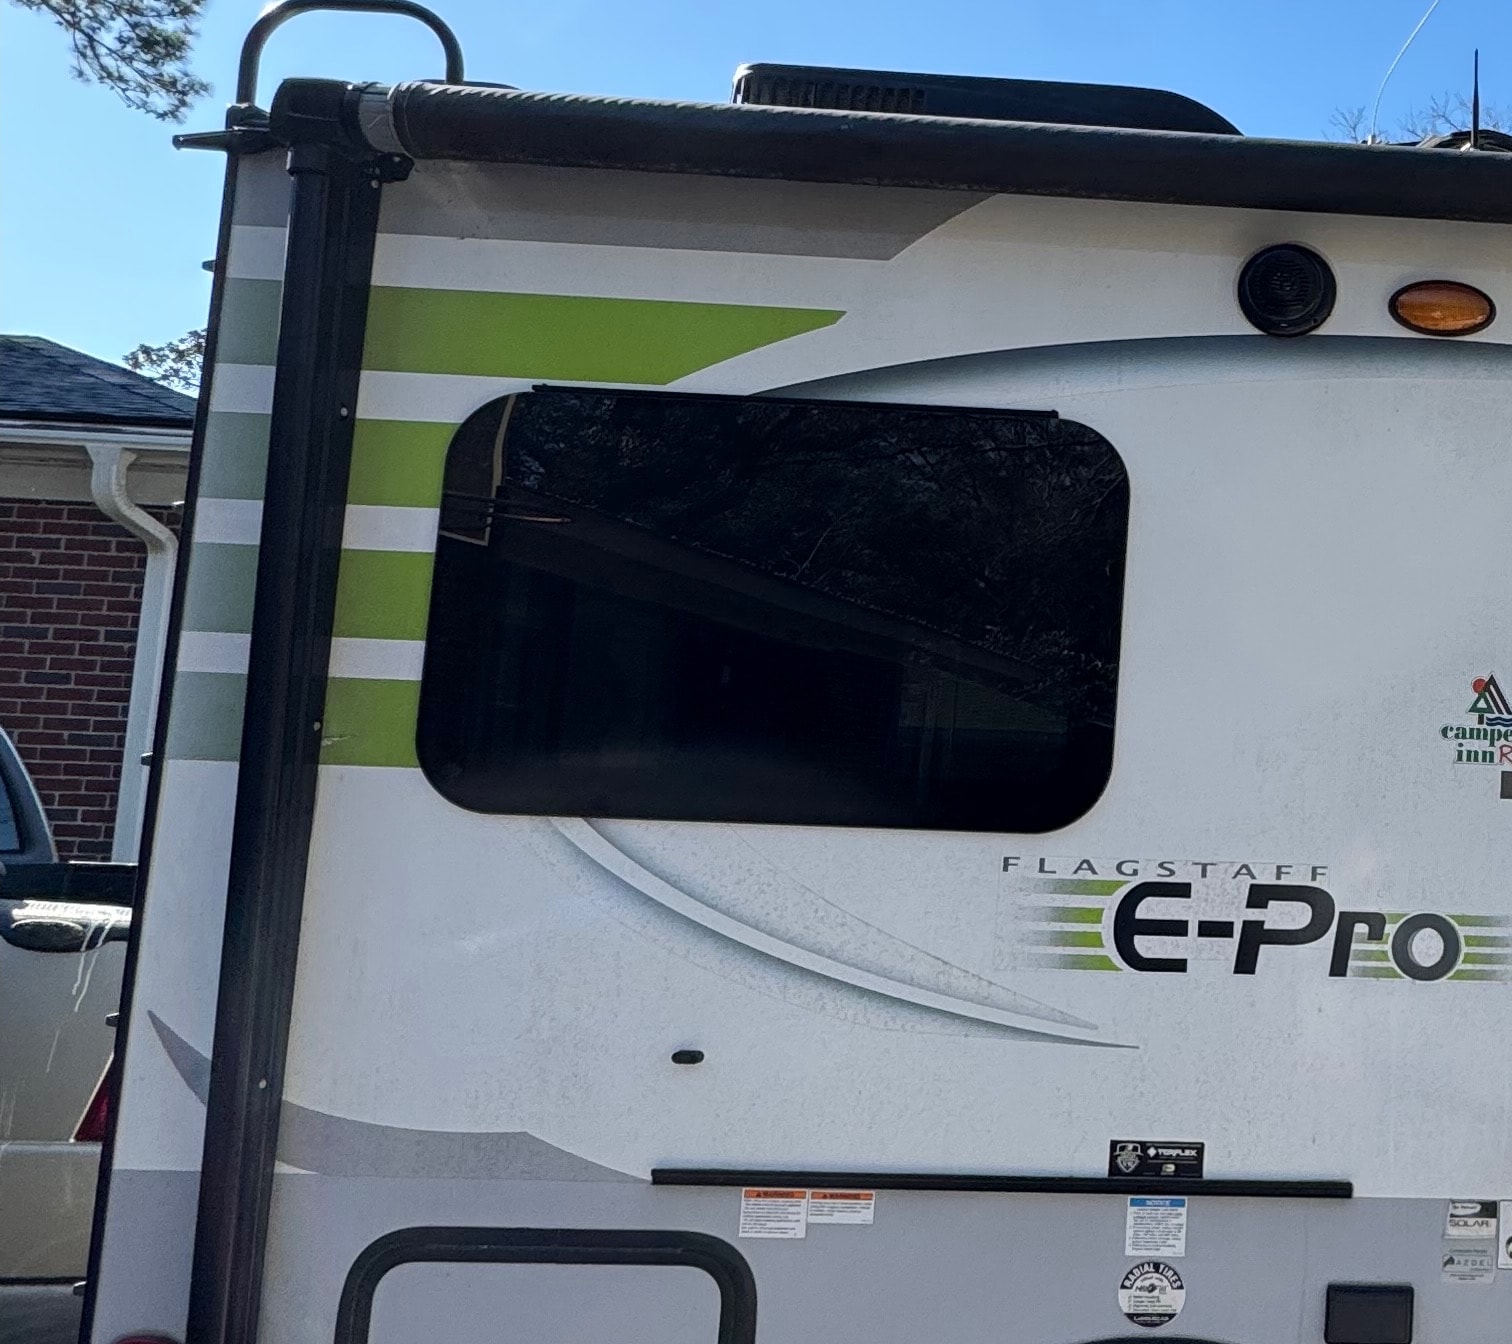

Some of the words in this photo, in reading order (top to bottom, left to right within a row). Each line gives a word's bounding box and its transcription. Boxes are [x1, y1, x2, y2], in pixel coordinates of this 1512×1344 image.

[1456, 742, 1495, 763] inn
[1002, 856, 1328, 882] FLAGSTAFF
[1114, 882, 1462, 981] E-Pro
[1449, 1219, 1489, 1227] SOLAR
[1123, 1262, 1155, 1288] RADIAL
[1159, 1263, 1182, 1288] TIRES
